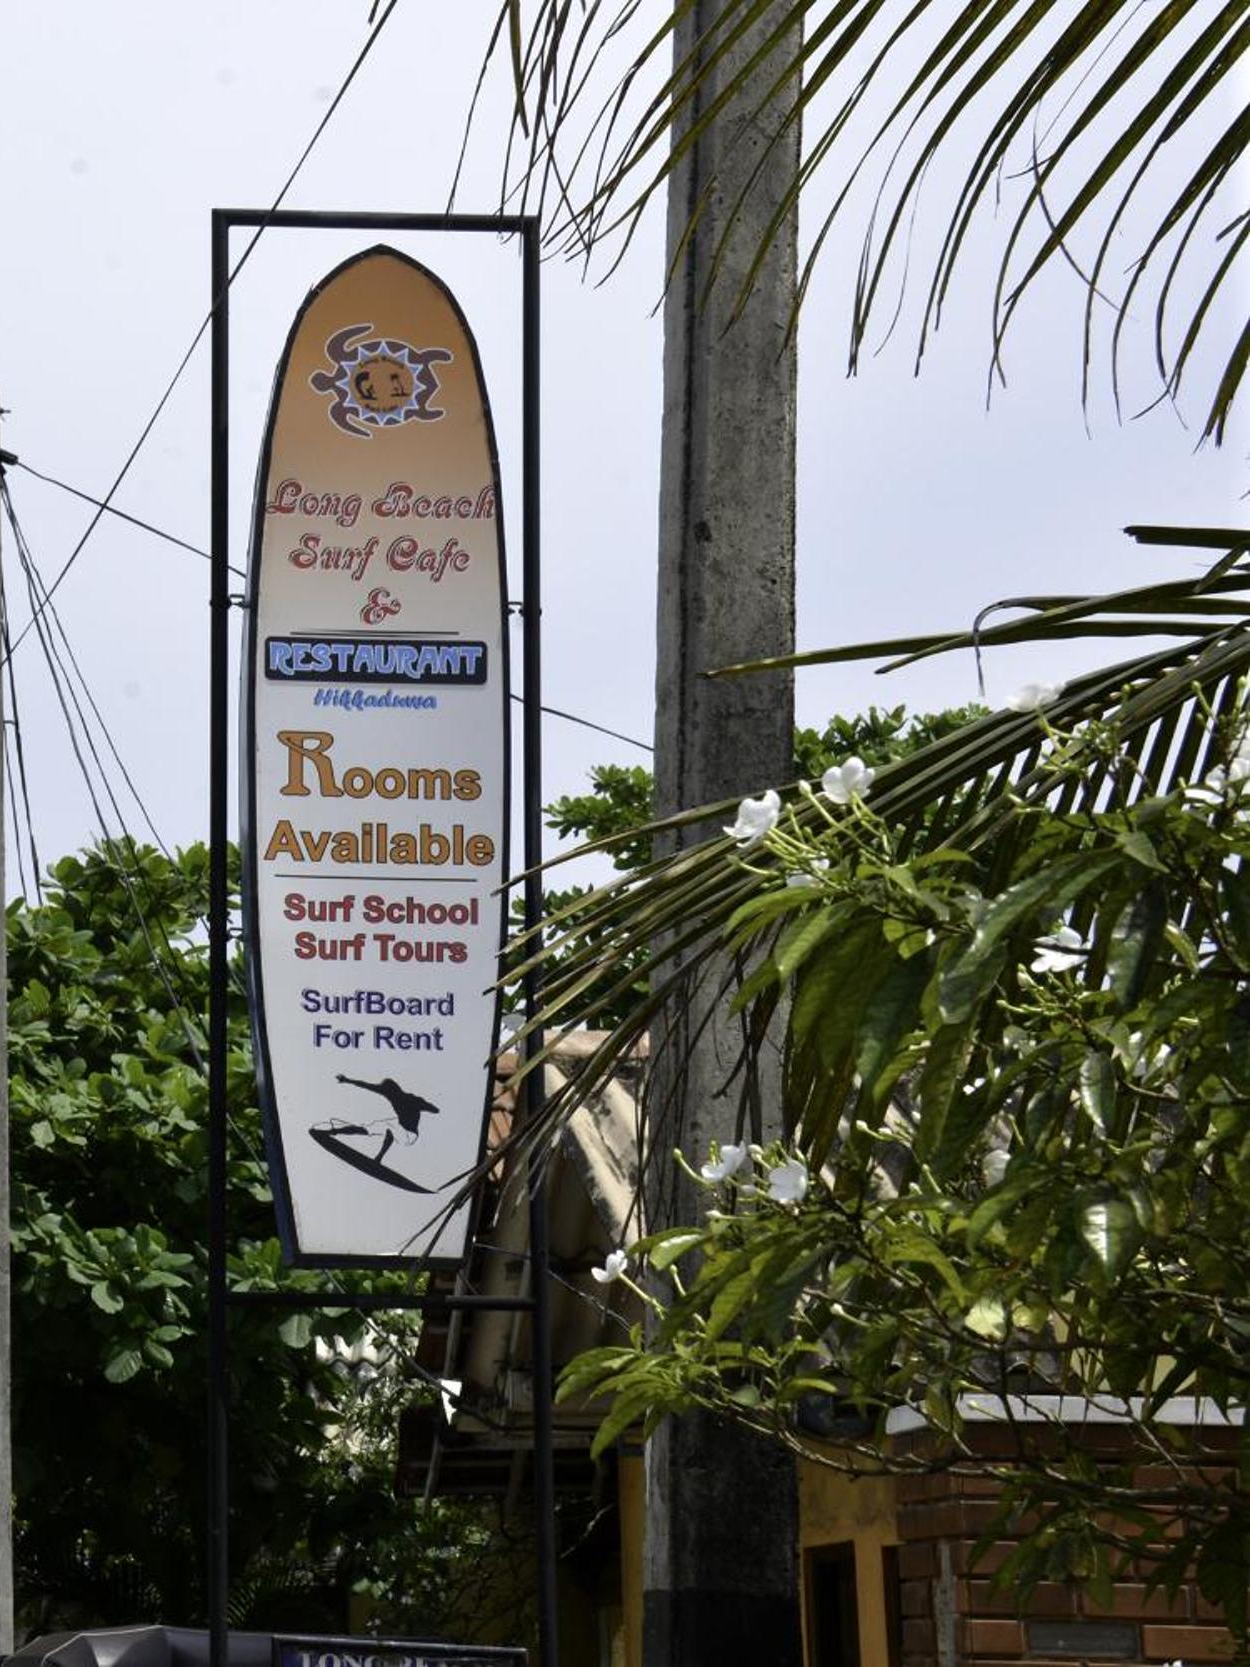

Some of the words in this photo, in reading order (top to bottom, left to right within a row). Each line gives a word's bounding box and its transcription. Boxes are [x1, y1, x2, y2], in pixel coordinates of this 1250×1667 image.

[266, 479, 362, 527] Long
[371, 481, 496, 519] Beach
[289, 532, 379, 581] Surf
[386, 534, 470, 582] Cafe
[360, 587, 401, 625] &
[269, 641, 483, 678] RESTAURANT
[313, 688, 437, 711] Hikkaduwa
[276, 730, 482, 800] Rooms
[263, 820, 496, 866] Available
[283, 893, 355, 922] Surf
[362, 894, 479, 925] School
[294, 931, 366, 961] Surf
[374, 933, 469, 963] Tours
[302, 988, 455, 1016] SurfBoard
[313, 1024, 365, 1049] For
[373, 1025, 445, 1051] Rent
